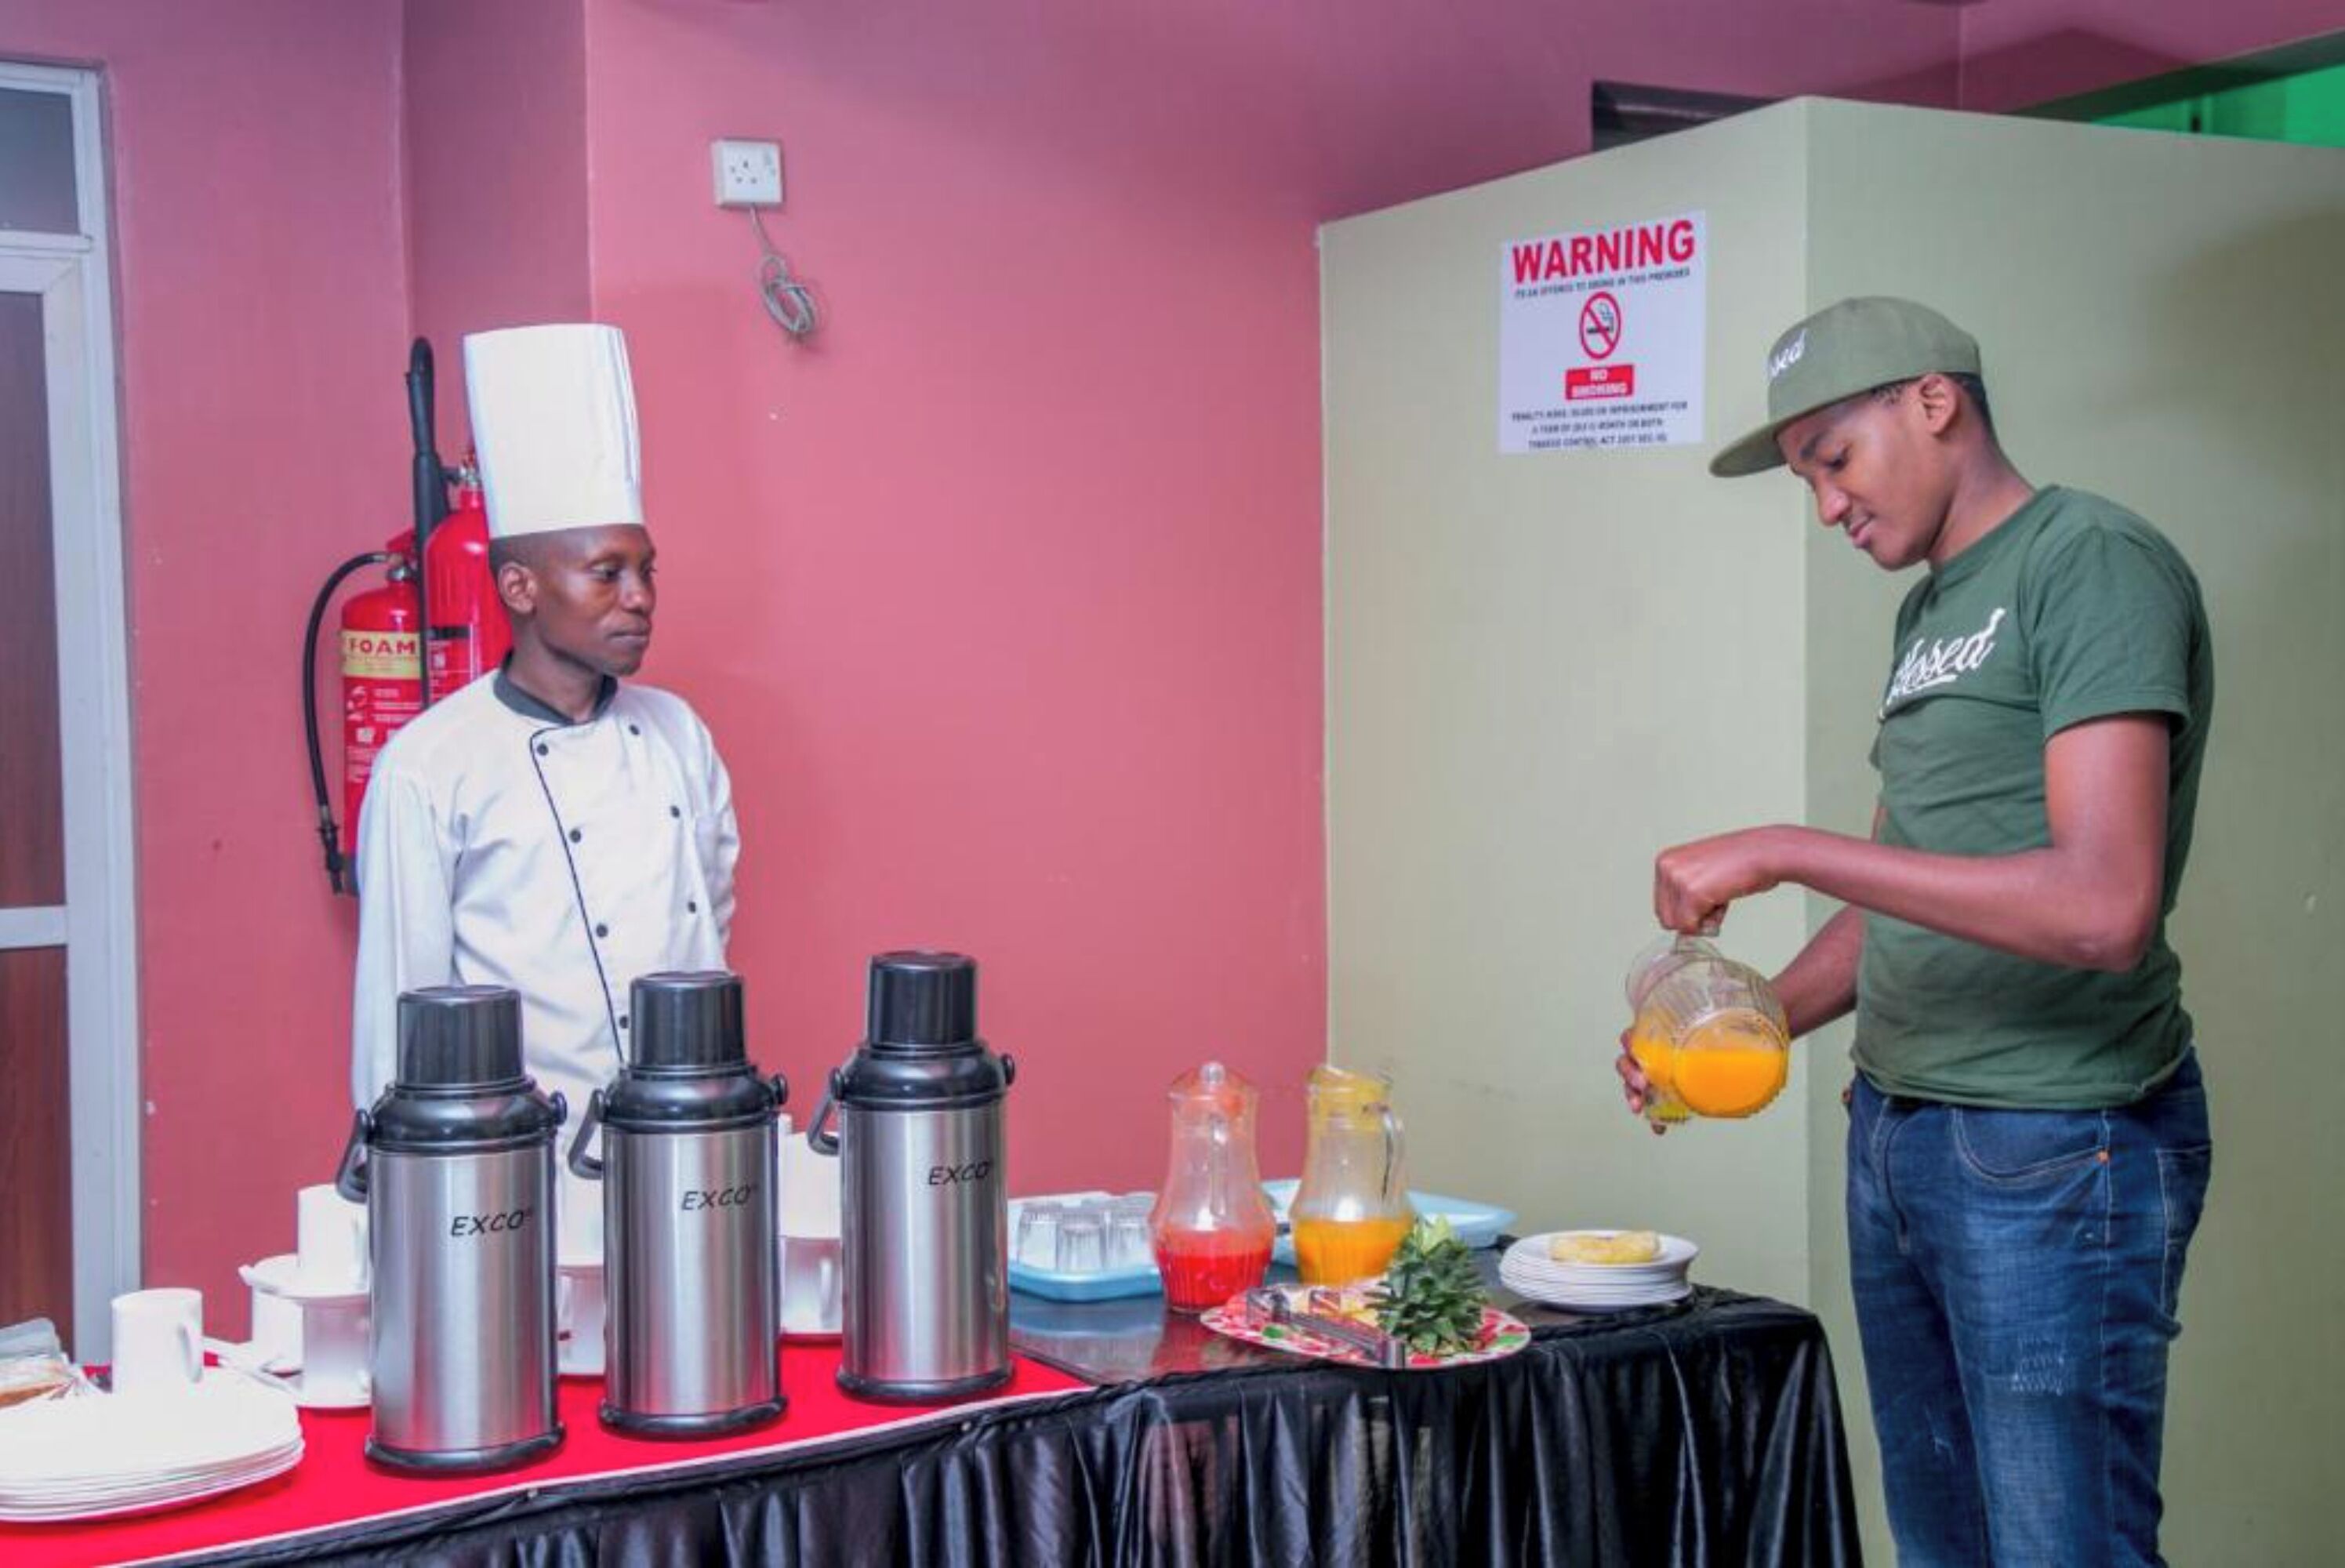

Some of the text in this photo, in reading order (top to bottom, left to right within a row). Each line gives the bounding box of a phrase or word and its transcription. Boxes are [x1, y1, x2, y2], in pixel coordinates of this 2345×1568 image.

[1512, 220, 1694, 283] WARNING
[1589, 368, 1608, 382] NO
[1571, 381, 1628, 398] SMOKING
[351, 638, 416, 654] FOAM
[451, 1210, 525, 1236] EXCO
